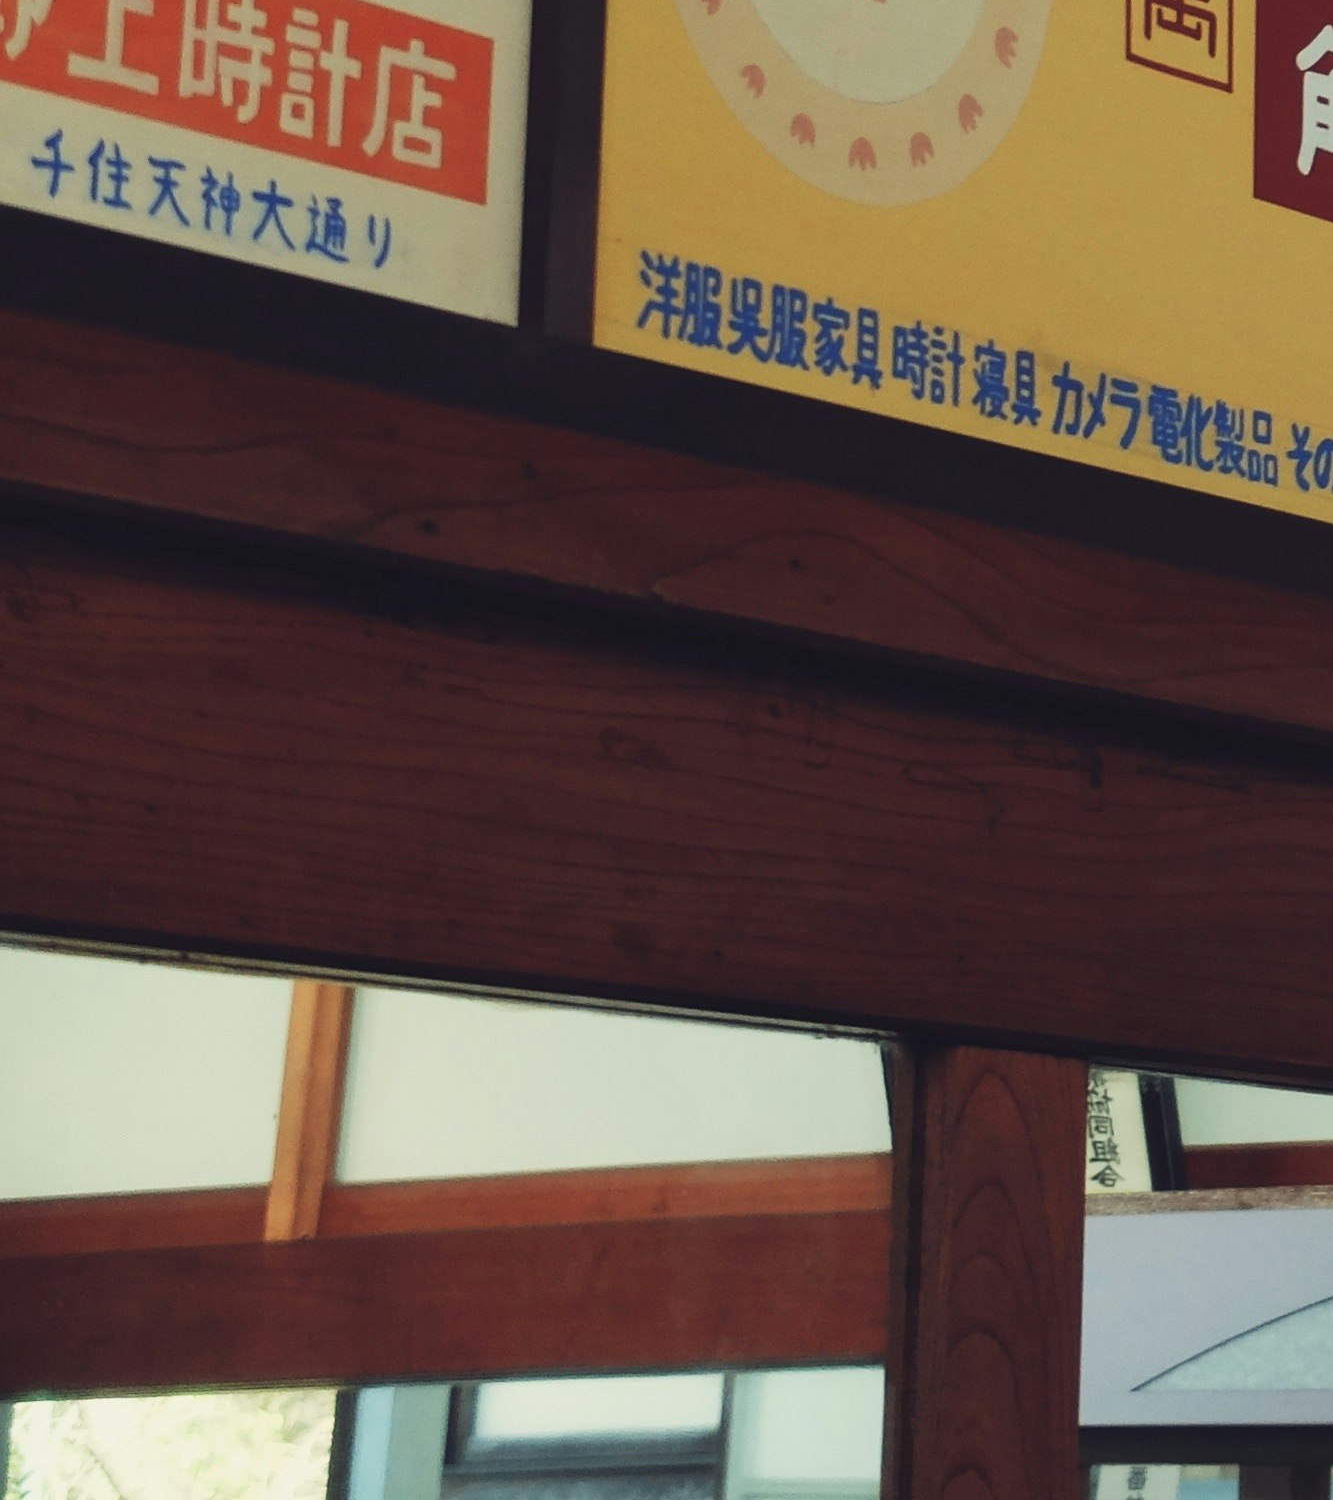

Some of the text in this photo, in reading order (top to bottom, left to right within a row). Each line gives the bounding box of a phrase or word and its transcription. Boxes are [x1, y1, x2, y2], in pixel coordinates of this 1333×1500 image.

[31, 129, 391, 268] 千住天神大通り
